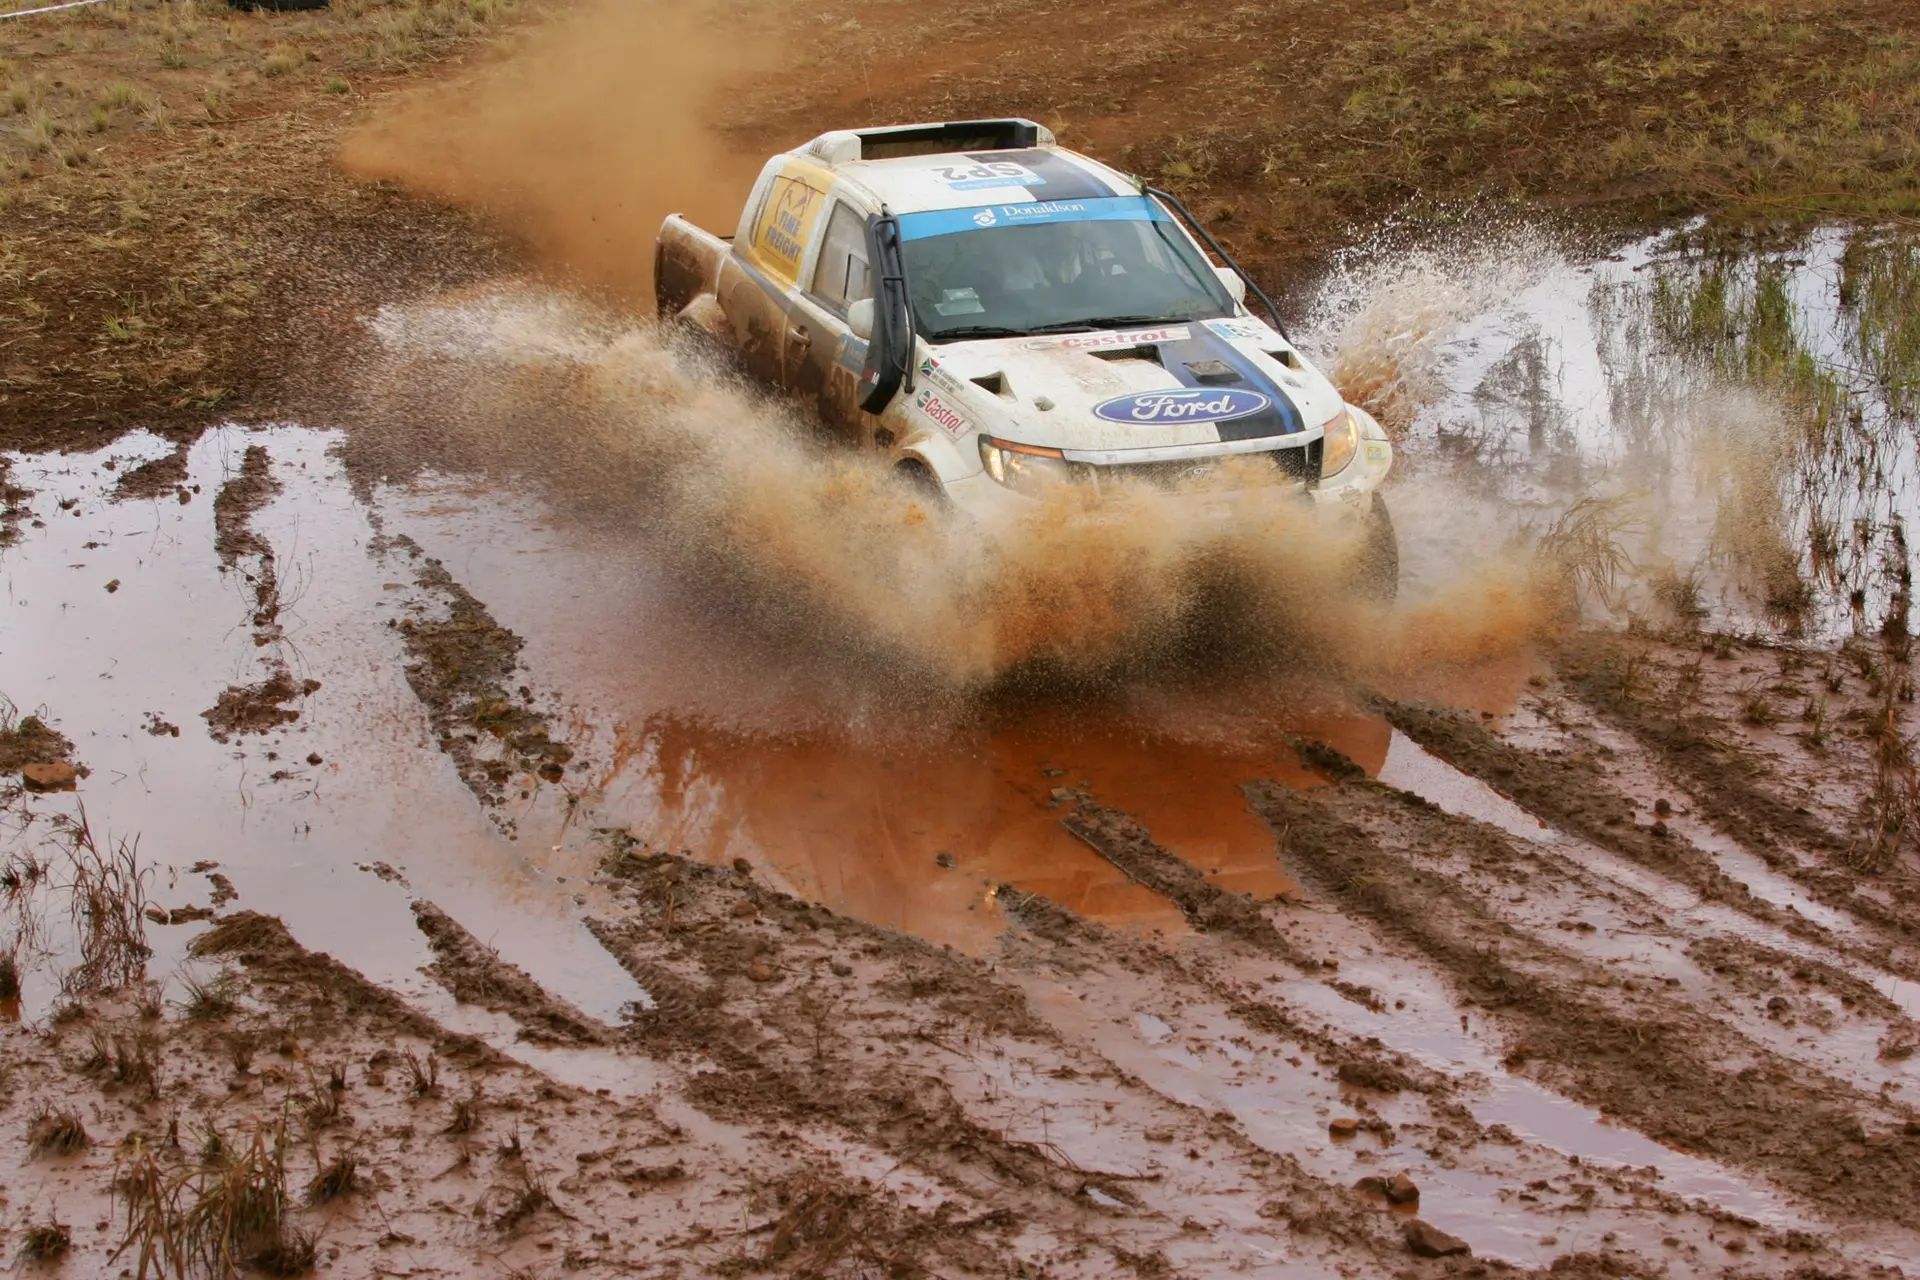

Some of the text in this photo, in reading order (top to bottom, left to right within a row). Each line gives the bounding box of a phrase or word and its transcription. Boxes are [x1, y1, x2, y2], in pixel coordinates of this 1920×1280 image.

[779, 209, 801, 239] TIME
[1002, 201, 1085, 217] Donaldson
[764, 224, 802, 263] FREIGHT
[1061, 329, 1174, 348] Castrol
[925, 398, 965, 433] Castrol
[1131, 390, 1236, 420] Ford
